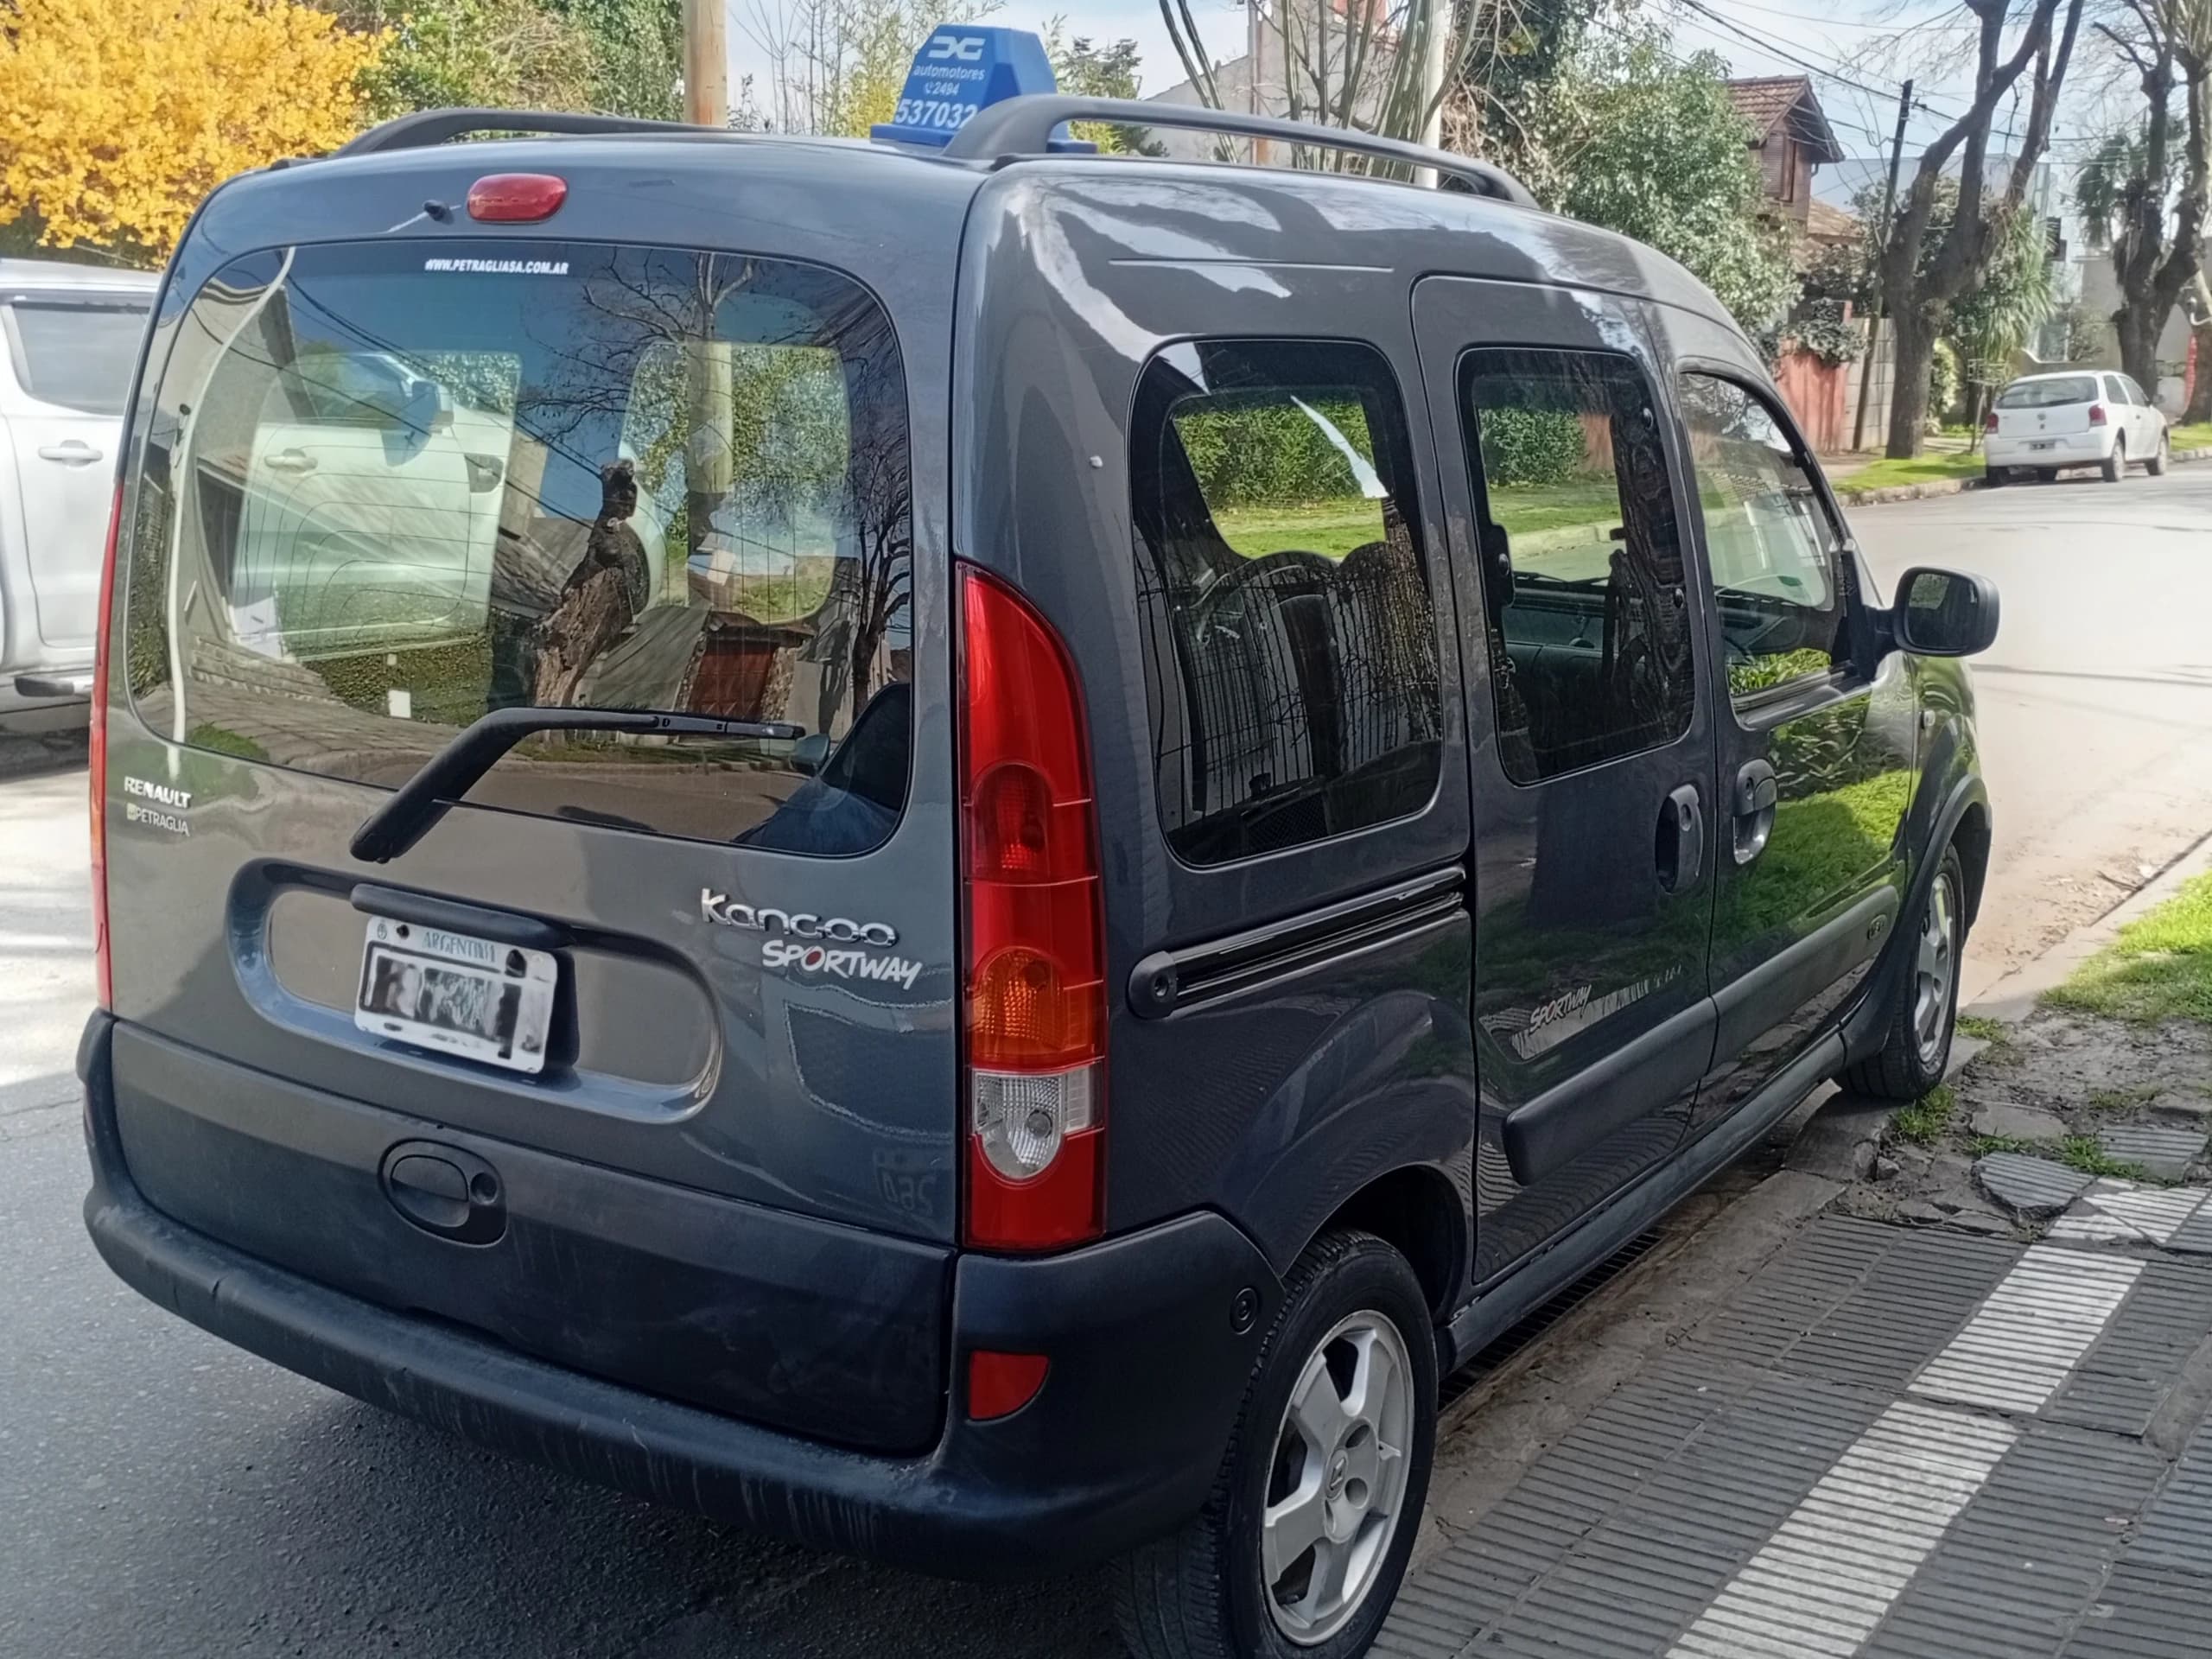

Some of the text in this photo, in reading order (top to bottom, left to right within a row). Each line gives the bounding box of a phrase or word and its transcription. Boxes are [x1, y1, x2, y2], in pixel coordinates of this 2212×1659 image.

[913, 64, 985, 81] automotores
[895, 99, 978, 129] 537032
[424, 258, 569, 275] WWW.PETRAGLIASA.COM.AR
[124, 776, 191, 809] RENAULT
[133, 805, 190, 836] PETRAGLIA
[423, 931, 496, 963] ARGENTINA
[762, 939, 923, 990] SPORTWAY
[1529, 983, 1592, 1035] SPORTWAY
